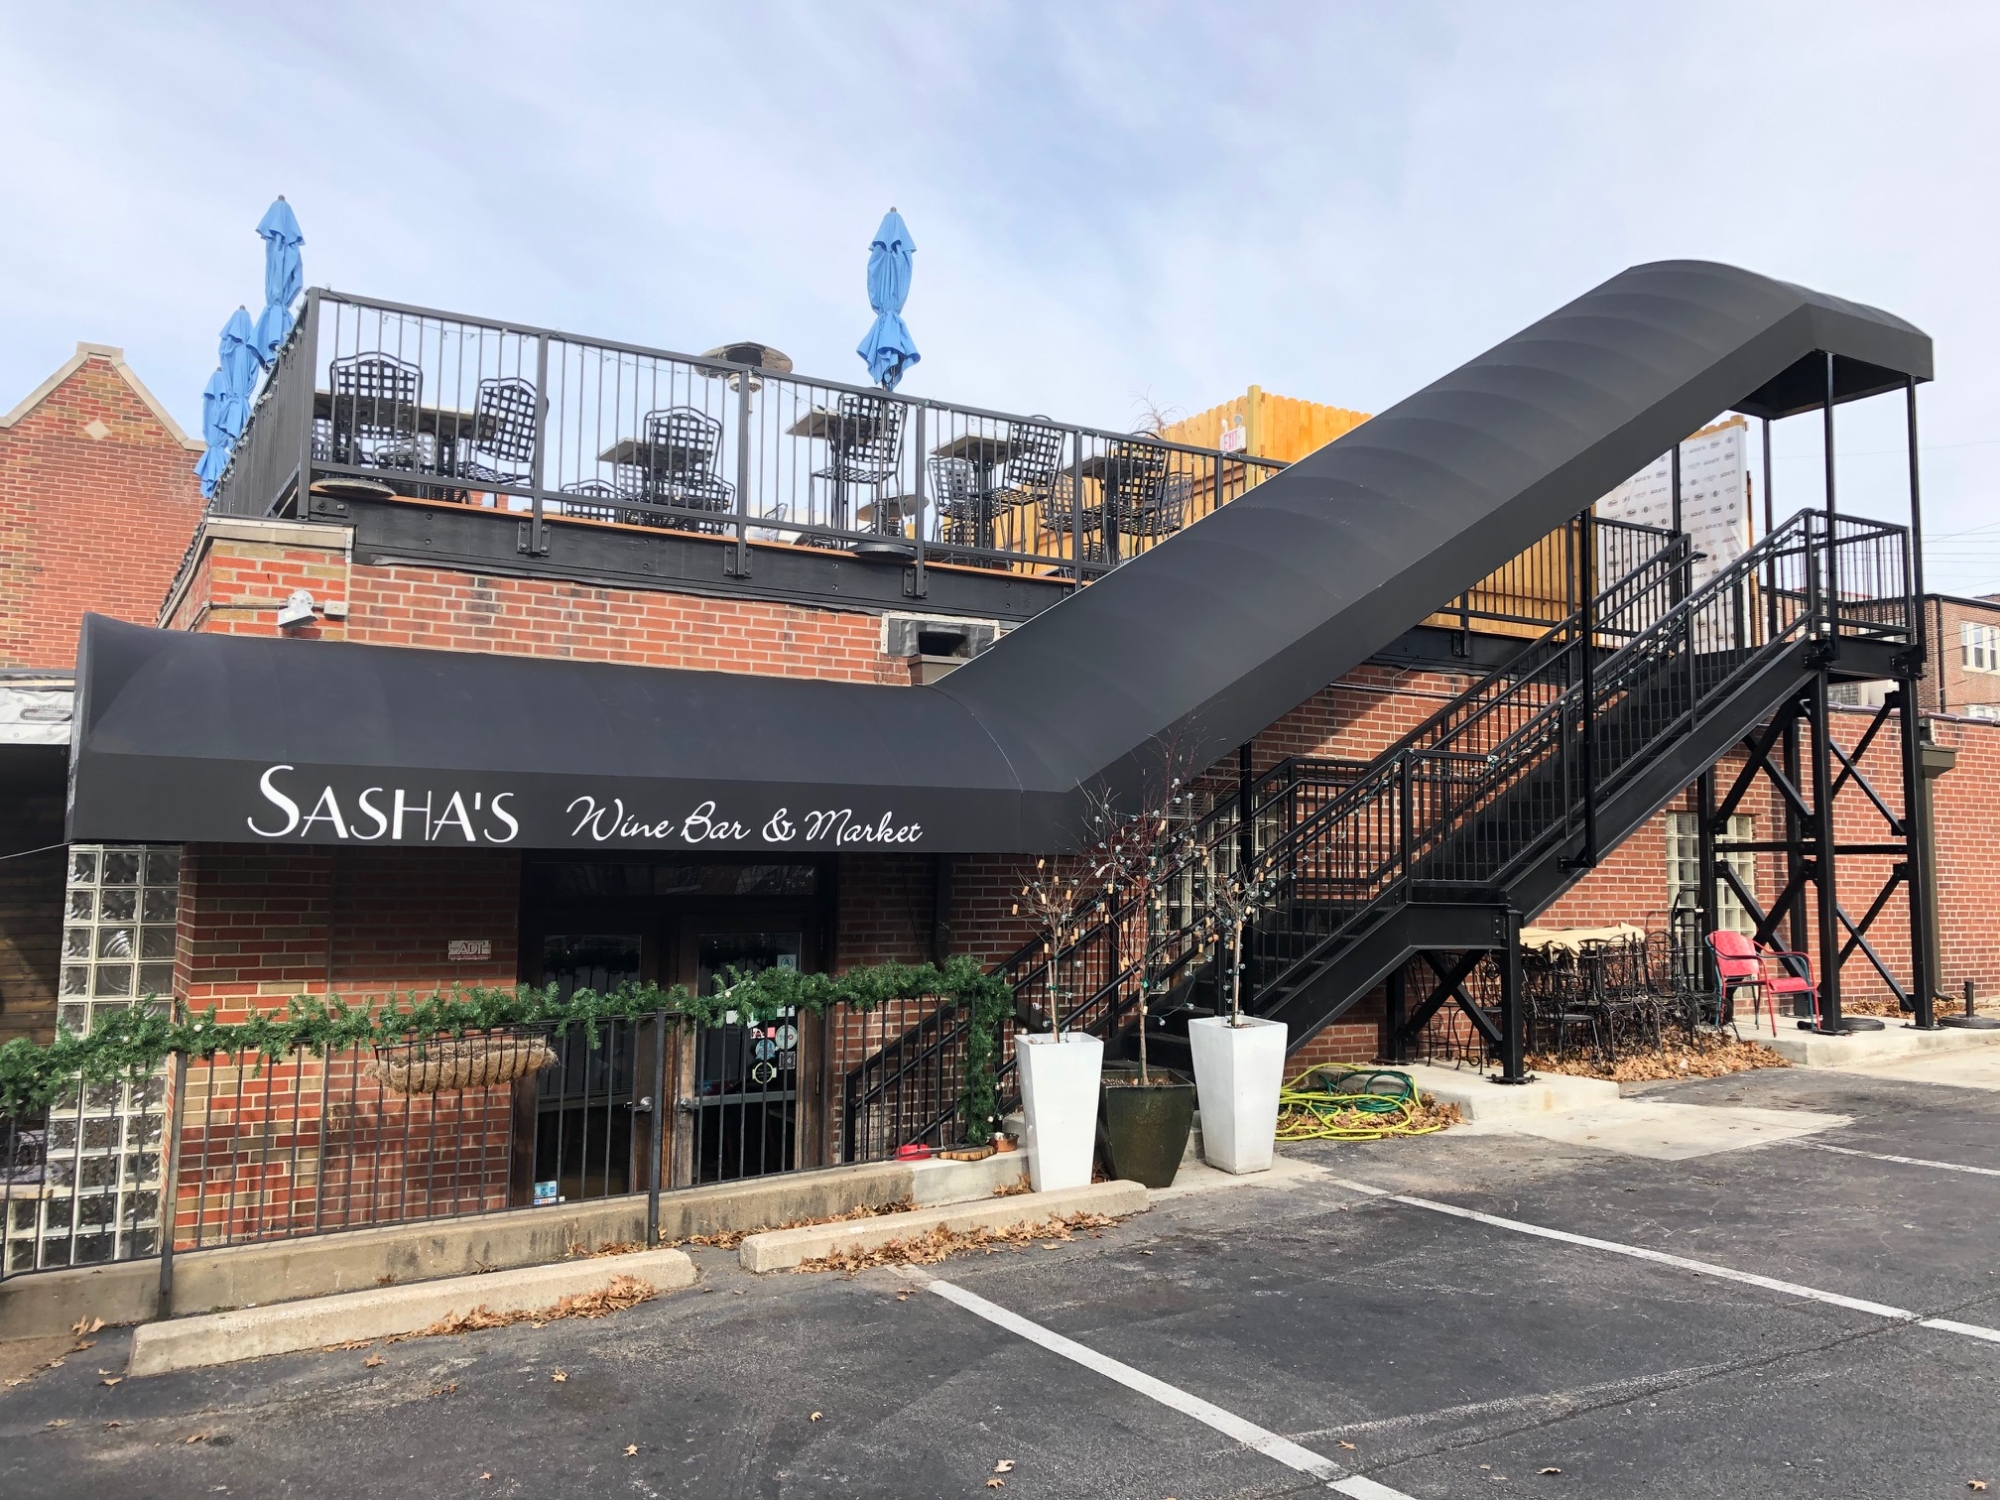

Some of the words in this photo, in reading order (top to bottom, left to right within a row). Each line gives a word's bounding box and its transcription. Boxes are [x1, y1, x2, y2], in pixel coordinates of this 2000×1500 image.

[1223, 430, 1238, 452] EXIT
[247, 764, 520, 843] SASHA'S
[566, 795, 675, 842] Wine
[680, 800, 753, 842] Bar
[762, 807, 797, 843] &
[804, 809, 923, 846] Market
[457, 941, 484, 955] ADT
